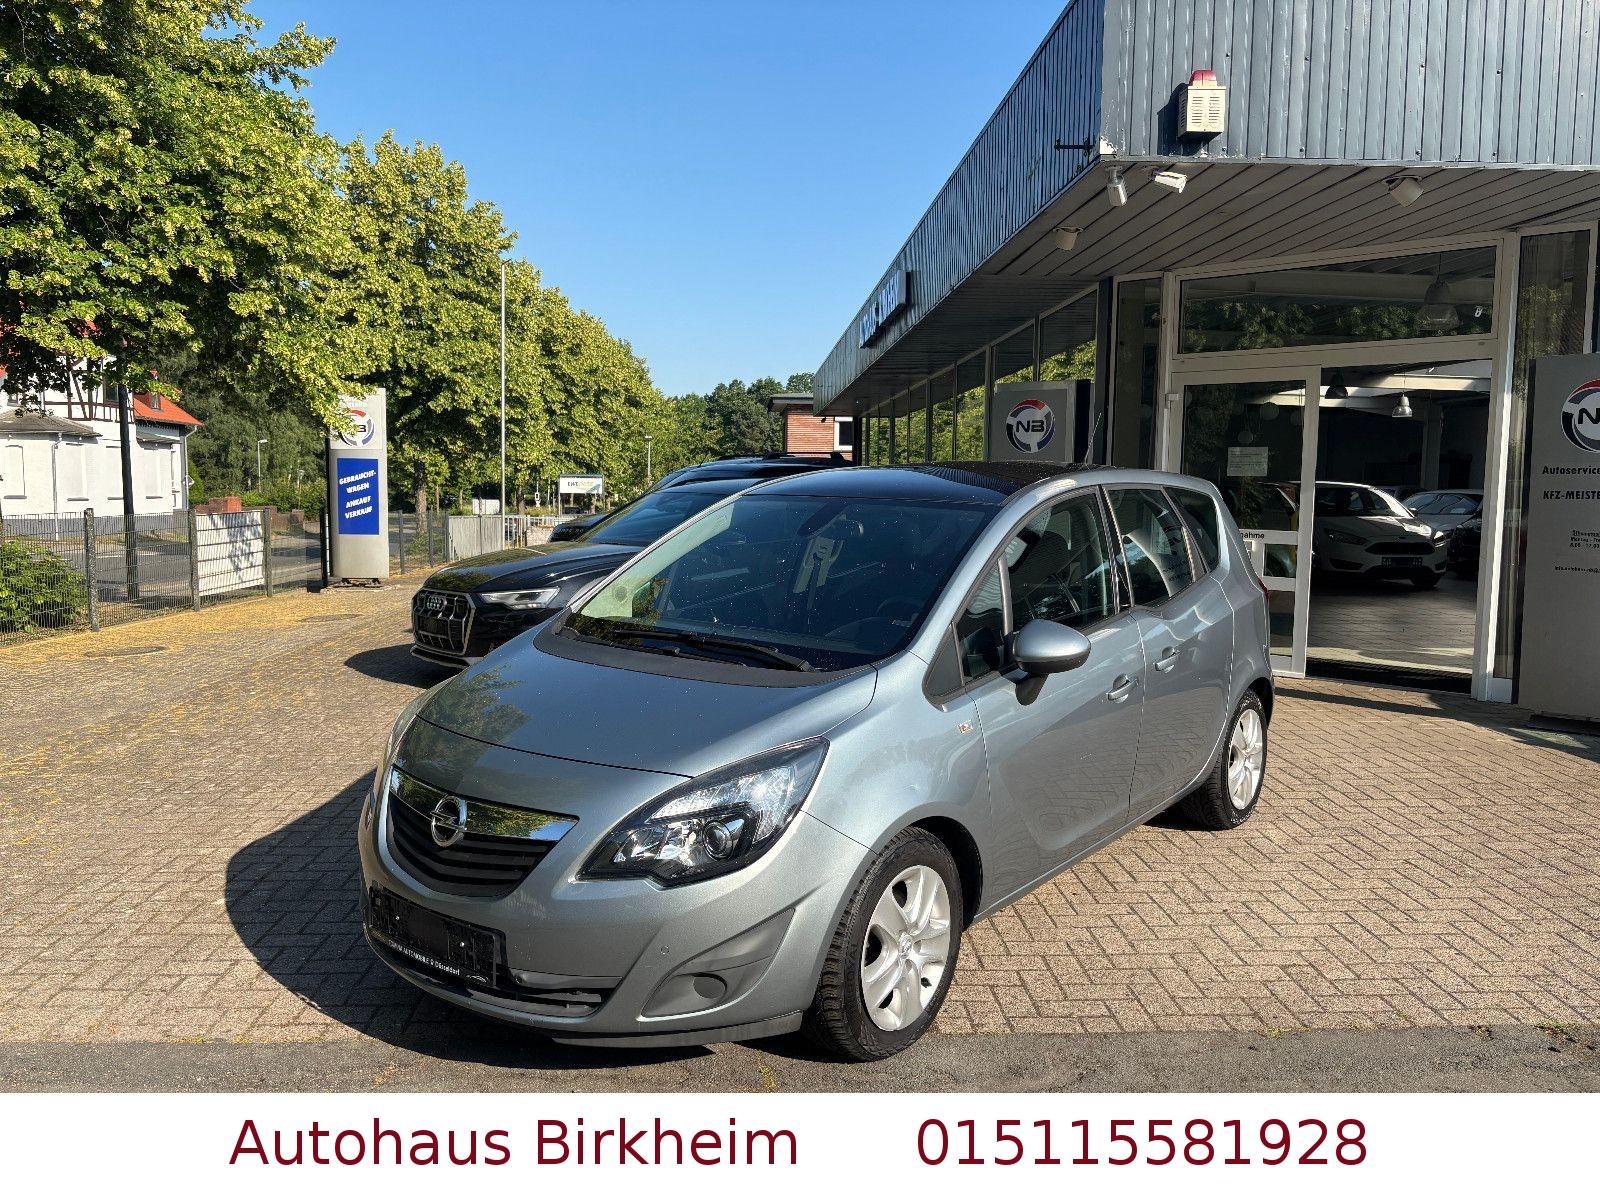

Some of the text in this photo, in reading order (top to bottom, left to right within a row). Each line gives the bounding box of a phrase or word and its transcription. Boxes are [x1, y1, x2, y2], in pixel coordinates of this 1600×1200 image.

[1015, 419, 1045, 433] NB
[339, 469, 377, 485] GEBRAUCHT-
[346, 482, 370, 494] WAGEN
[345, 495, 372, 509] ANKAUF
[344, 505, 373, 519] VERKAUF
